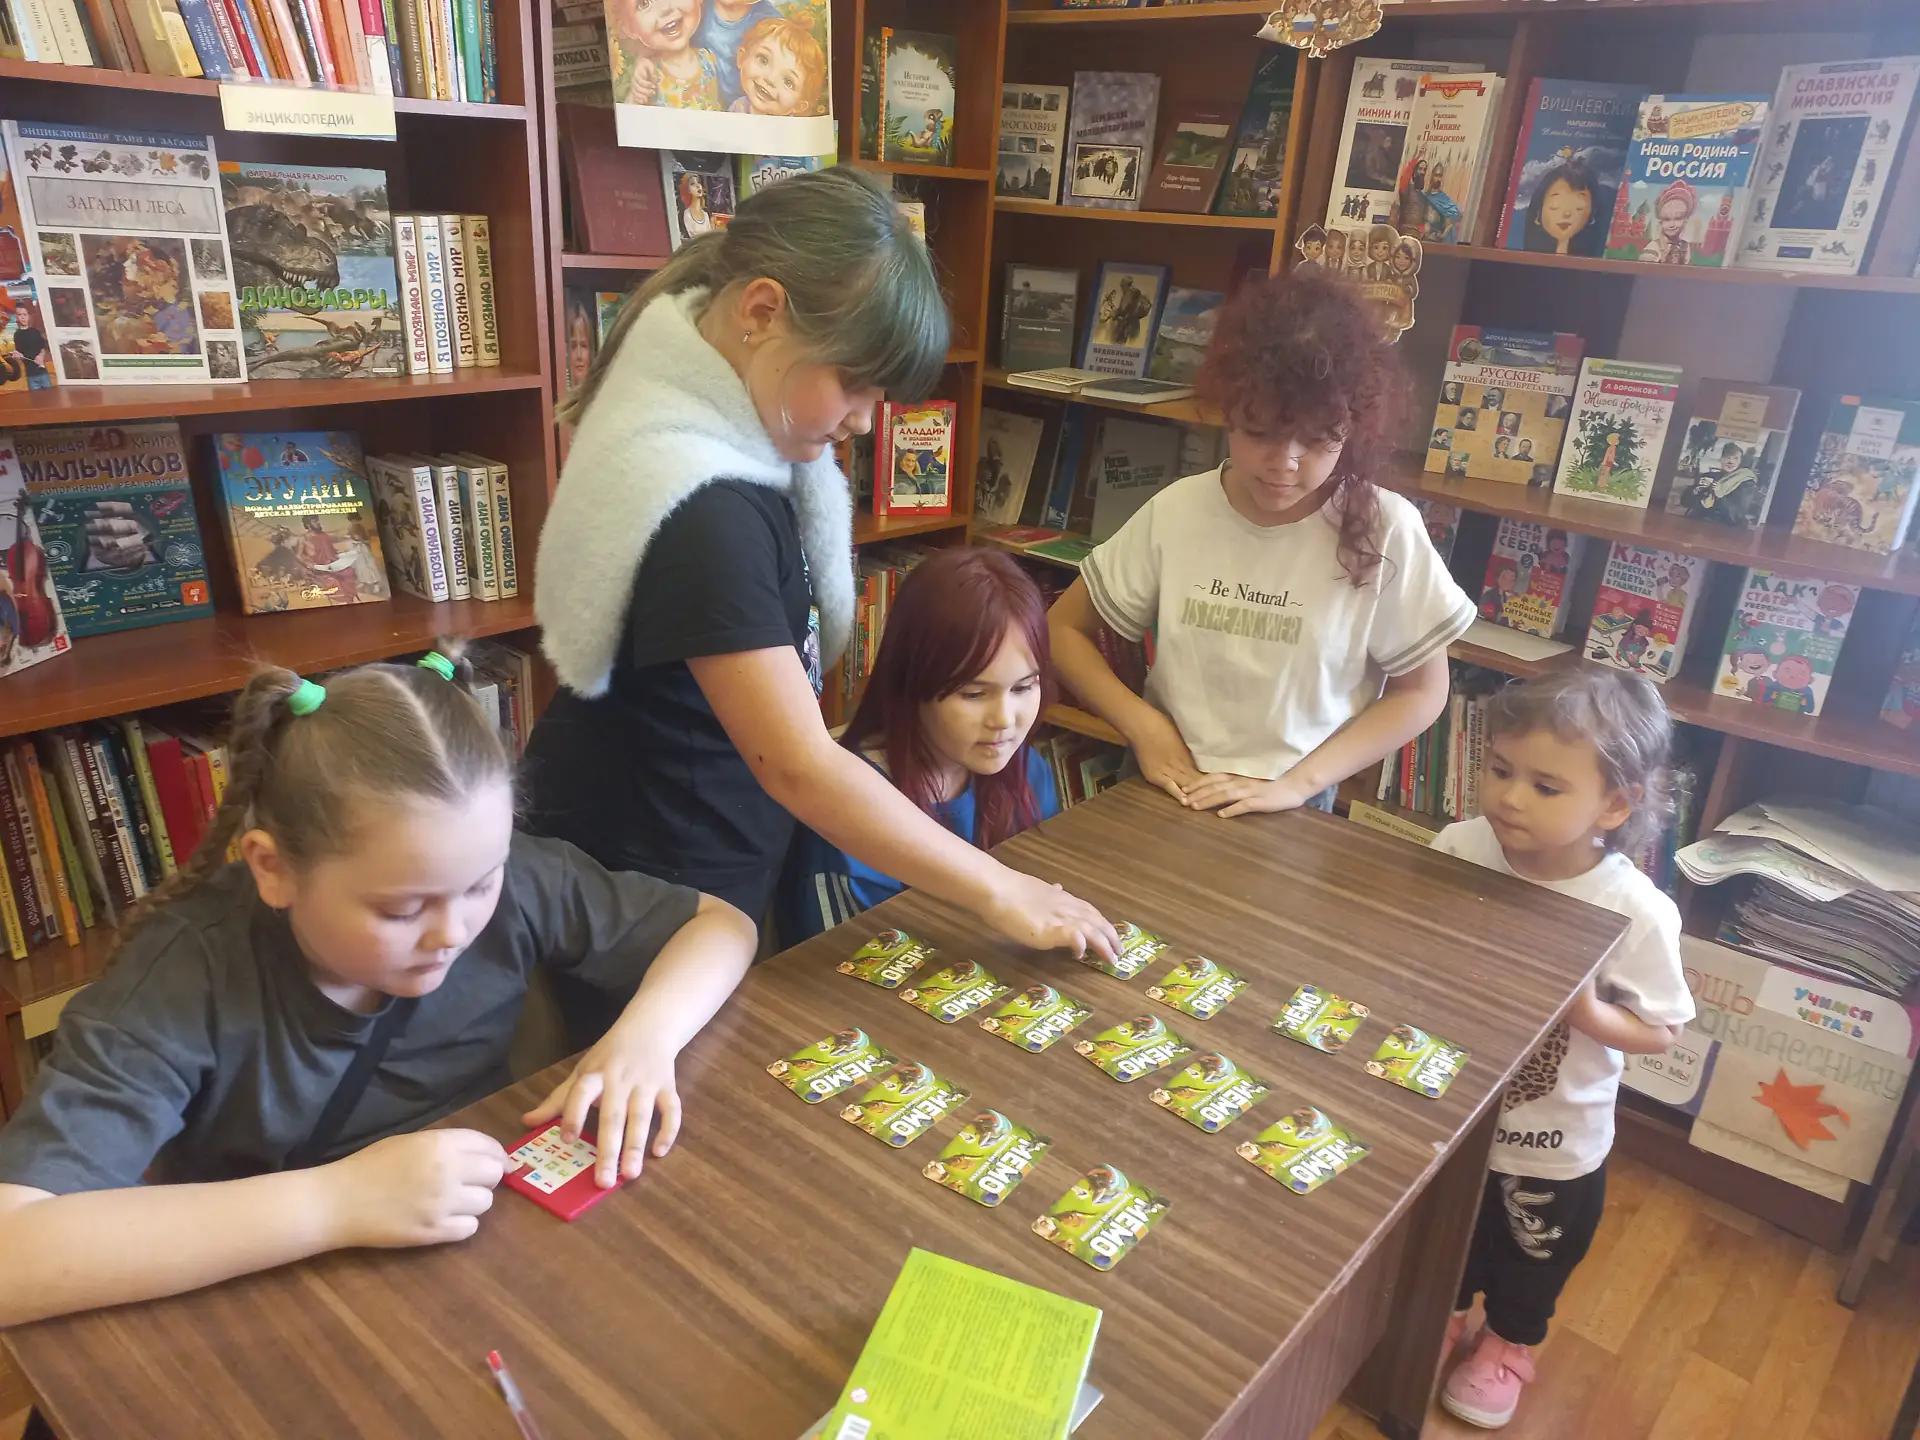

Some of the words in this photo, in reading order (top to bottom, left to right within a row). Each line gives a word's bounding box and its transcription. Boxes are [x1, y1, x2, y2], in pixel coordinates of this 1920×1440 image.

[1795, 73, 1901, 94] СЛАВЯНСКАЯ
[1790, 90, 1895, 110] МИФОЛОГИЯ
[247, 111, 355, 127] ЭНЦИКЛОПЕДИИ
[1357, 107, 1392, 119] МИНИН
[1394, 110, 1401, 119] И
[1673, 107, 1741, 126] ЭНЦИКЛОПЕДИЯ
[1001, 120, 1057, 132] МОСКОВИЯ
[1431, 119, 1461, 131] Минине
[21, 127, 110, 141] ЭНЦИКЛОПЕДИЯ
[115, 134, 142, 143] ТАЙН
[148, 136, 156, 144] И
[160, 138, 205, 148] ЗАГАДОК
[1422, 131, 1465, 144] Пожарском
[1682, 143, 1738, 159] РОДИНА
[247, 170, 302, 180] ВИРТУАЛЬНАЯ
[302, 173, 348, 182] РЕАЛЬНОСТЬ
[1645, 157, 1728, 179] РОССИЯ
[67, 195, 141, 213] ЗАГАДКИ
[146, 200, 187, 216] ЛЕСА
[403, 249, 419, 286] МИР
[425, 251, 442, 285] МИР
[449, 247, 464, 279] МИР
[476, 245, 489, 277] МИР
[240, 286, 387, 312] ДИНОЗАВРЫ
[408, 286, 427, 348] ПОЗНАЮ
[431, 288, 449, 349] ПОЗНАЮ
[454, 283, 472, 341] ПОЗНАЮ
[481, 281, 496, 341] ПОЗНАЮ
[413, 349, 427, 363] Я
[437, 352, 451, 364] Я
[460, 345, 473, 355] Я
[484, 343, 497, 354] Я
[1452, 374, 1488, 385] УЧЕНЫЕ
[1498, 380, 1565, 394] ИЗОБРЕТАТЕЛИ
[1480, 366, 1541, 384] РУССКИЕ
[1613, 384, 1659, 395] ВОРОНКОВА
[16, 439, 86, 456] БОЛЬШАЯ
[90, 427, 127, 452] 4D
[131, 435, 177, 449] КНИГА
[899, 427, 946, 436] АЛАДДИН
[21, 452, 183, 483] МАЛЬЧИКОВ
[39, 482, 113, 496] ДОПОЛНЕННОЙ
[244, 474, 355, 503] ЭРУДИТ
[244, 505, 273, 513] НОВАЯ
[276, 501, 363, 511] ИЛЛЮСТРИРОВАННАЯ
[292, 507, 357, 516] ЭНЦИКЛОПЕДИЯ
[420, 496, 435, 525] МИР
[449, 499, 461, 525] МИР
[476, 500, 490, 527] МИР
[496, 494, 510, 523] МИР
[1501, 527, 1542, 543] ВЕСТИ
[426, 527, 444, 580] ПОЗНАЮ
[451, 527, 468, 576] ПОЗНАЮ
[479, 528, 494, 578] ПОЗНАЮ
[500, 525, 515, 578] ПОЗНАЮ
[1499, 535, 1541, 556] СЕБЯ
[1612, 542, 1658, 570] КАК
[1607, 568, 1645, 586] СИДЕТЬ
[1610, 560, 1657, 579] ПЕРЕСТАТЬ
[432, 580, 446, 592] Я
[455, 577, 468, 587] Я
[484, 579, 496, 589] Я
[503, 578, 516, 589] Я
[1611, 579, 1653, 597] ГАДЖЕТАХ
[1749, 574, 1806, 598] КАК
[1209, 578, 1230, 598] Be
[1234, 583, 1289, 607] Natural
[1745, 591, 1791, 607] СТАТЬ
[1504, 607, 1551, 626] СИТУАЦИЯХ
[1512, 602, 1553, 618] ОПАСНЫХ
[1652, 619, 1677, 632] ЗНАТЬ
[1768, 612, 1807, 629] СЕБЕ
[83, 741, 97, 770] книга
[92, 769, 107, 806] красная
[1794, 986, 1875, 1023] УЧИМСЯ
[1797, 1007, 1865, 1039] ЧИТАТЬ
[1673, 1049, 1696, 1066] МУ
[1643, 1055, 1663, 1071] МО
[1668, 1065, 1691, 1081] МЫ
